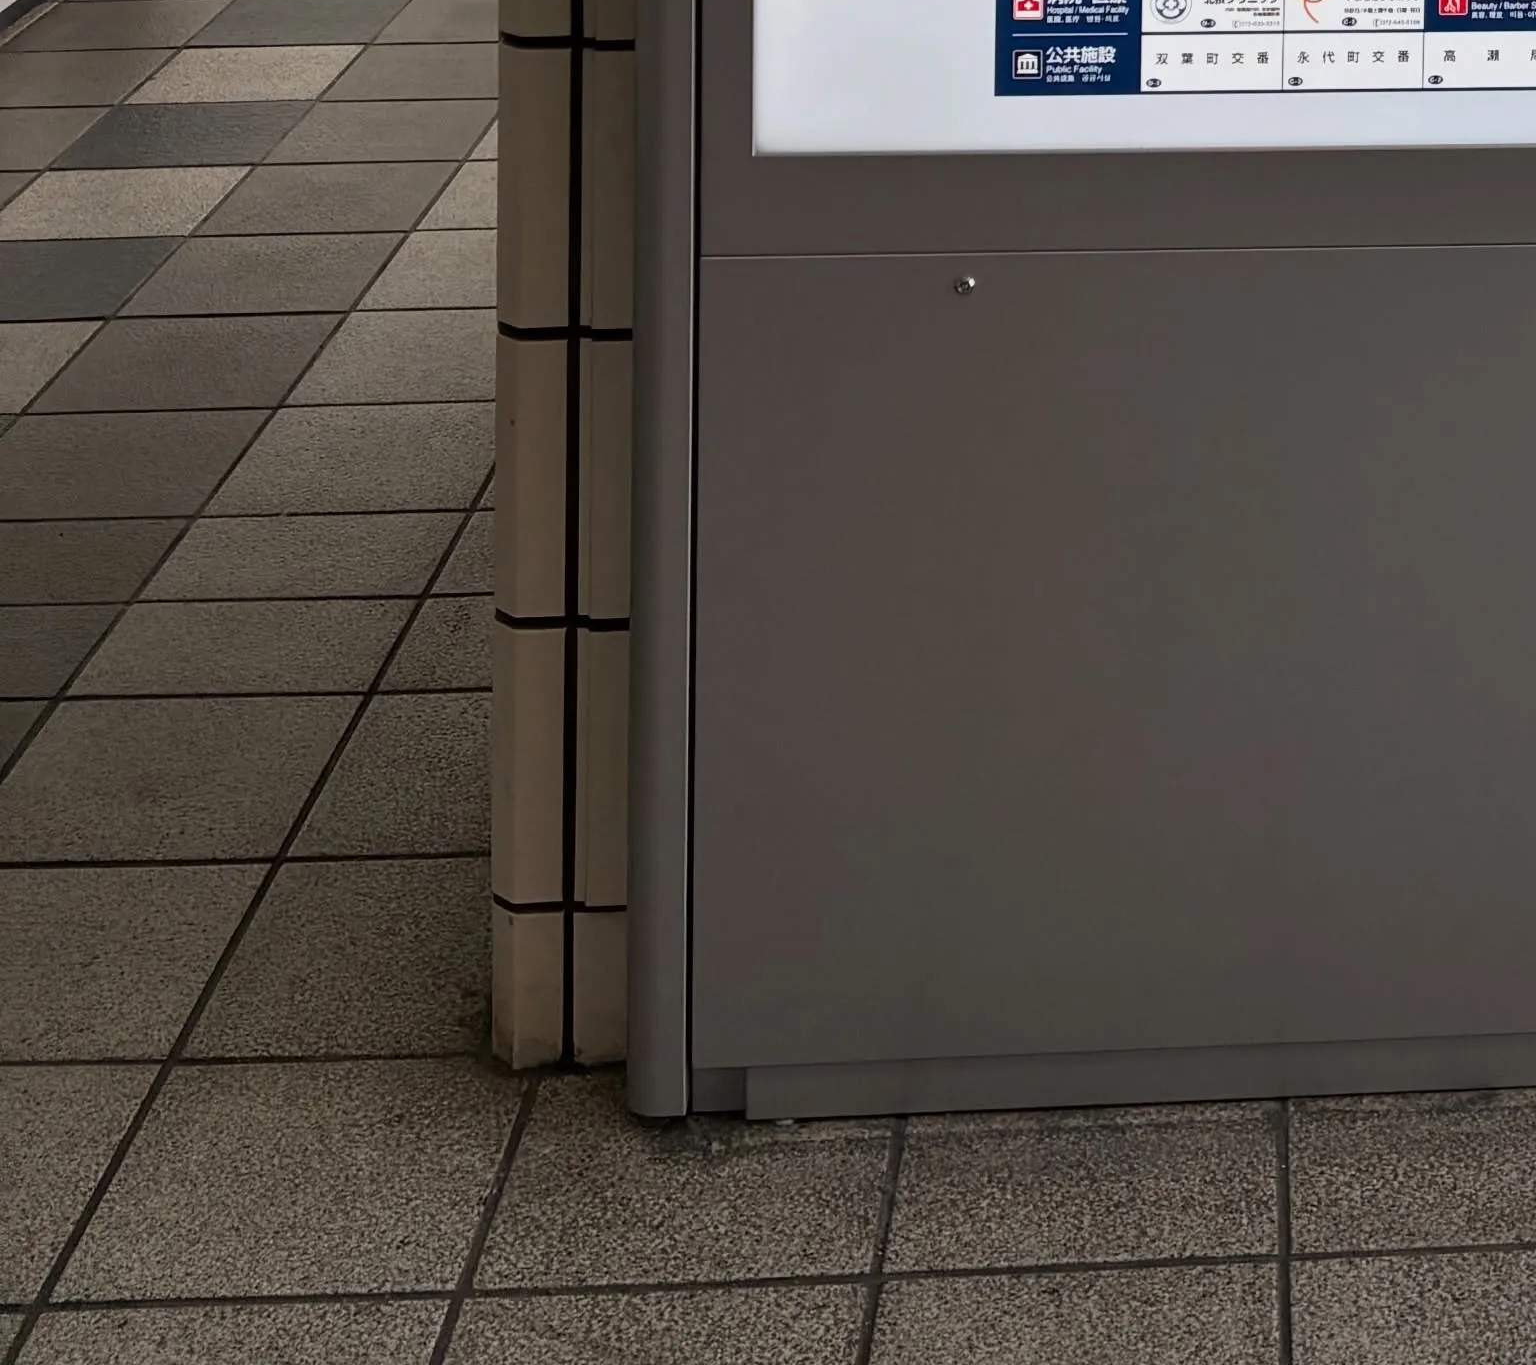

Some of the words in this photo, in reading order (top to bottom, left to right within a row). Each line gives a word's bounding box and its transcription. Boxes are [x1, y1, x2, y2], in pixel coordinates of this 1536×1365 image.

[1471, 1, 1497, 11] Beauty
[1504, 1, 1529, 10] Barber
[1046, 47, 1116, 64] 公共施設
[1297, 51, 1410, 64] 永代町交番
[1046, 66, 1072, 74] Public
[1075, 66, 1102, 74] Facility
